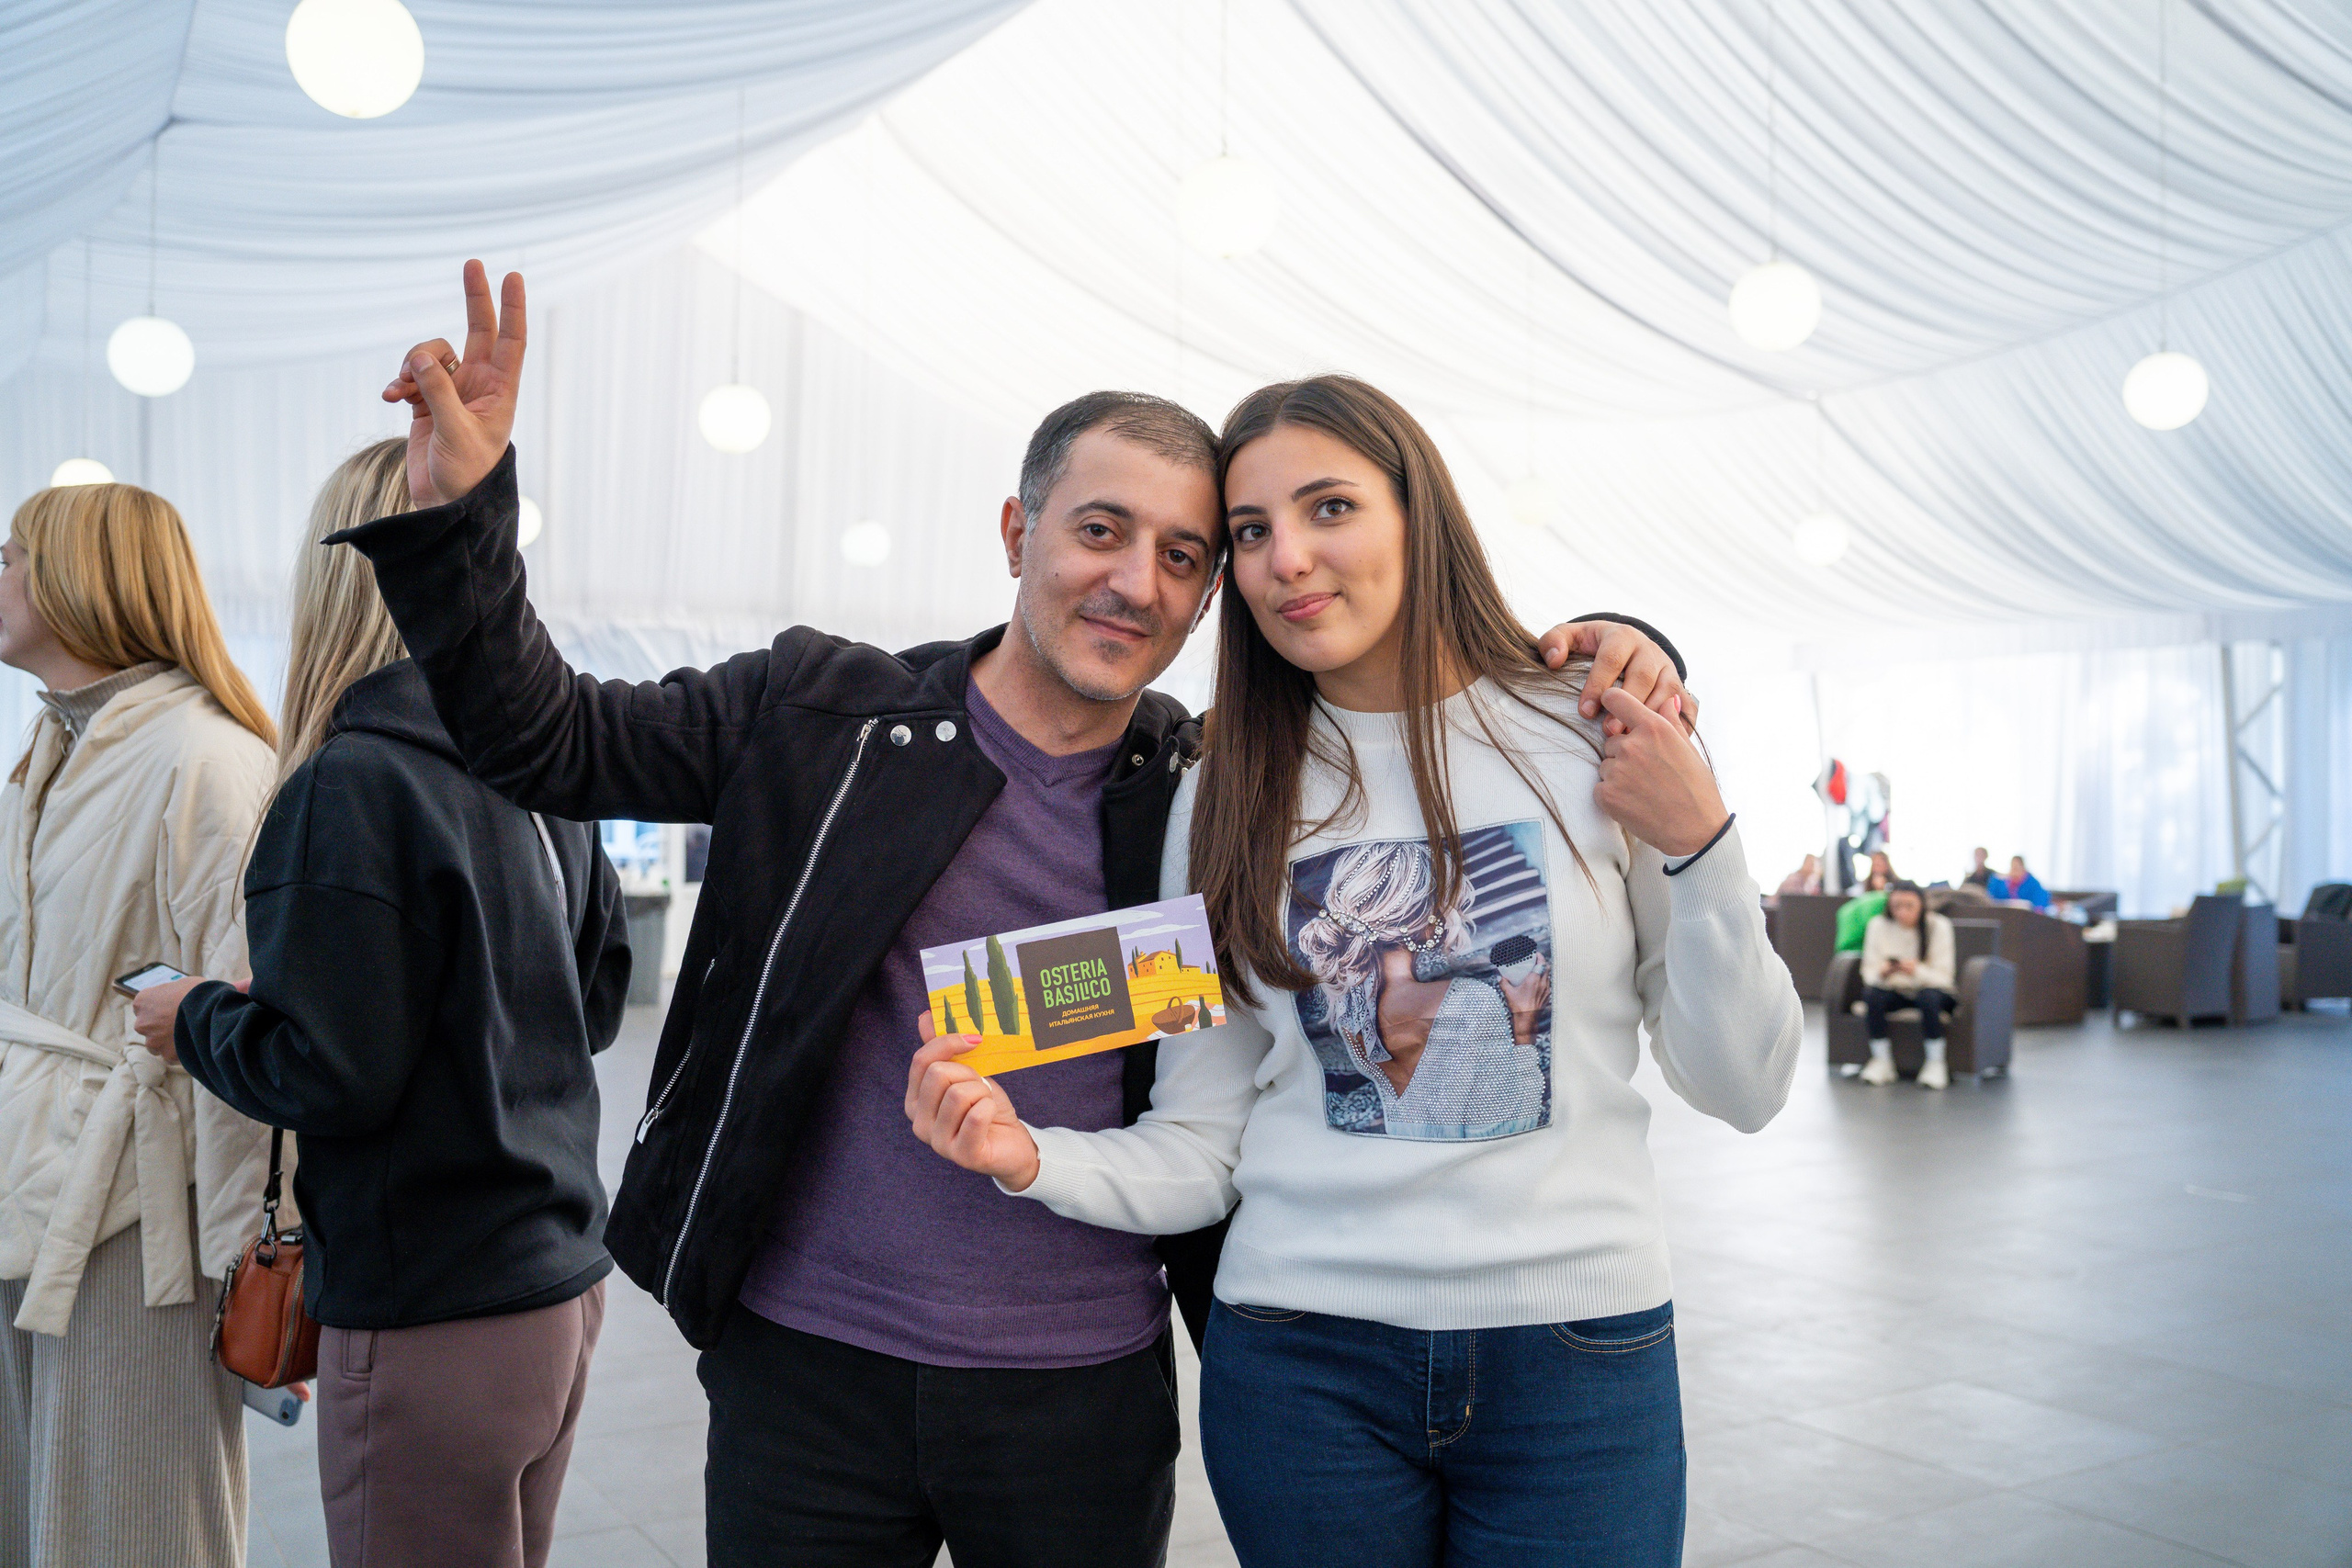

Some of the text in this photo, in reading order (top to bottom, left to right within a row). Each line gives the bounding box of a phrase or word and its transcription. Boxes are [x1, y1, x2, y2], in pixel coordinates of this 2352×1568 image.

[1040, 958, 1108, 988] OSTERIA
[1043, 977, 1111, 1009] BASILICO
[1048, 1009, 1115, 1028] ИТАЛЬЯНСКАЯ КУХНЯ
[1061, 1004, 1100, 1018] ДОМАШНЯЯ
